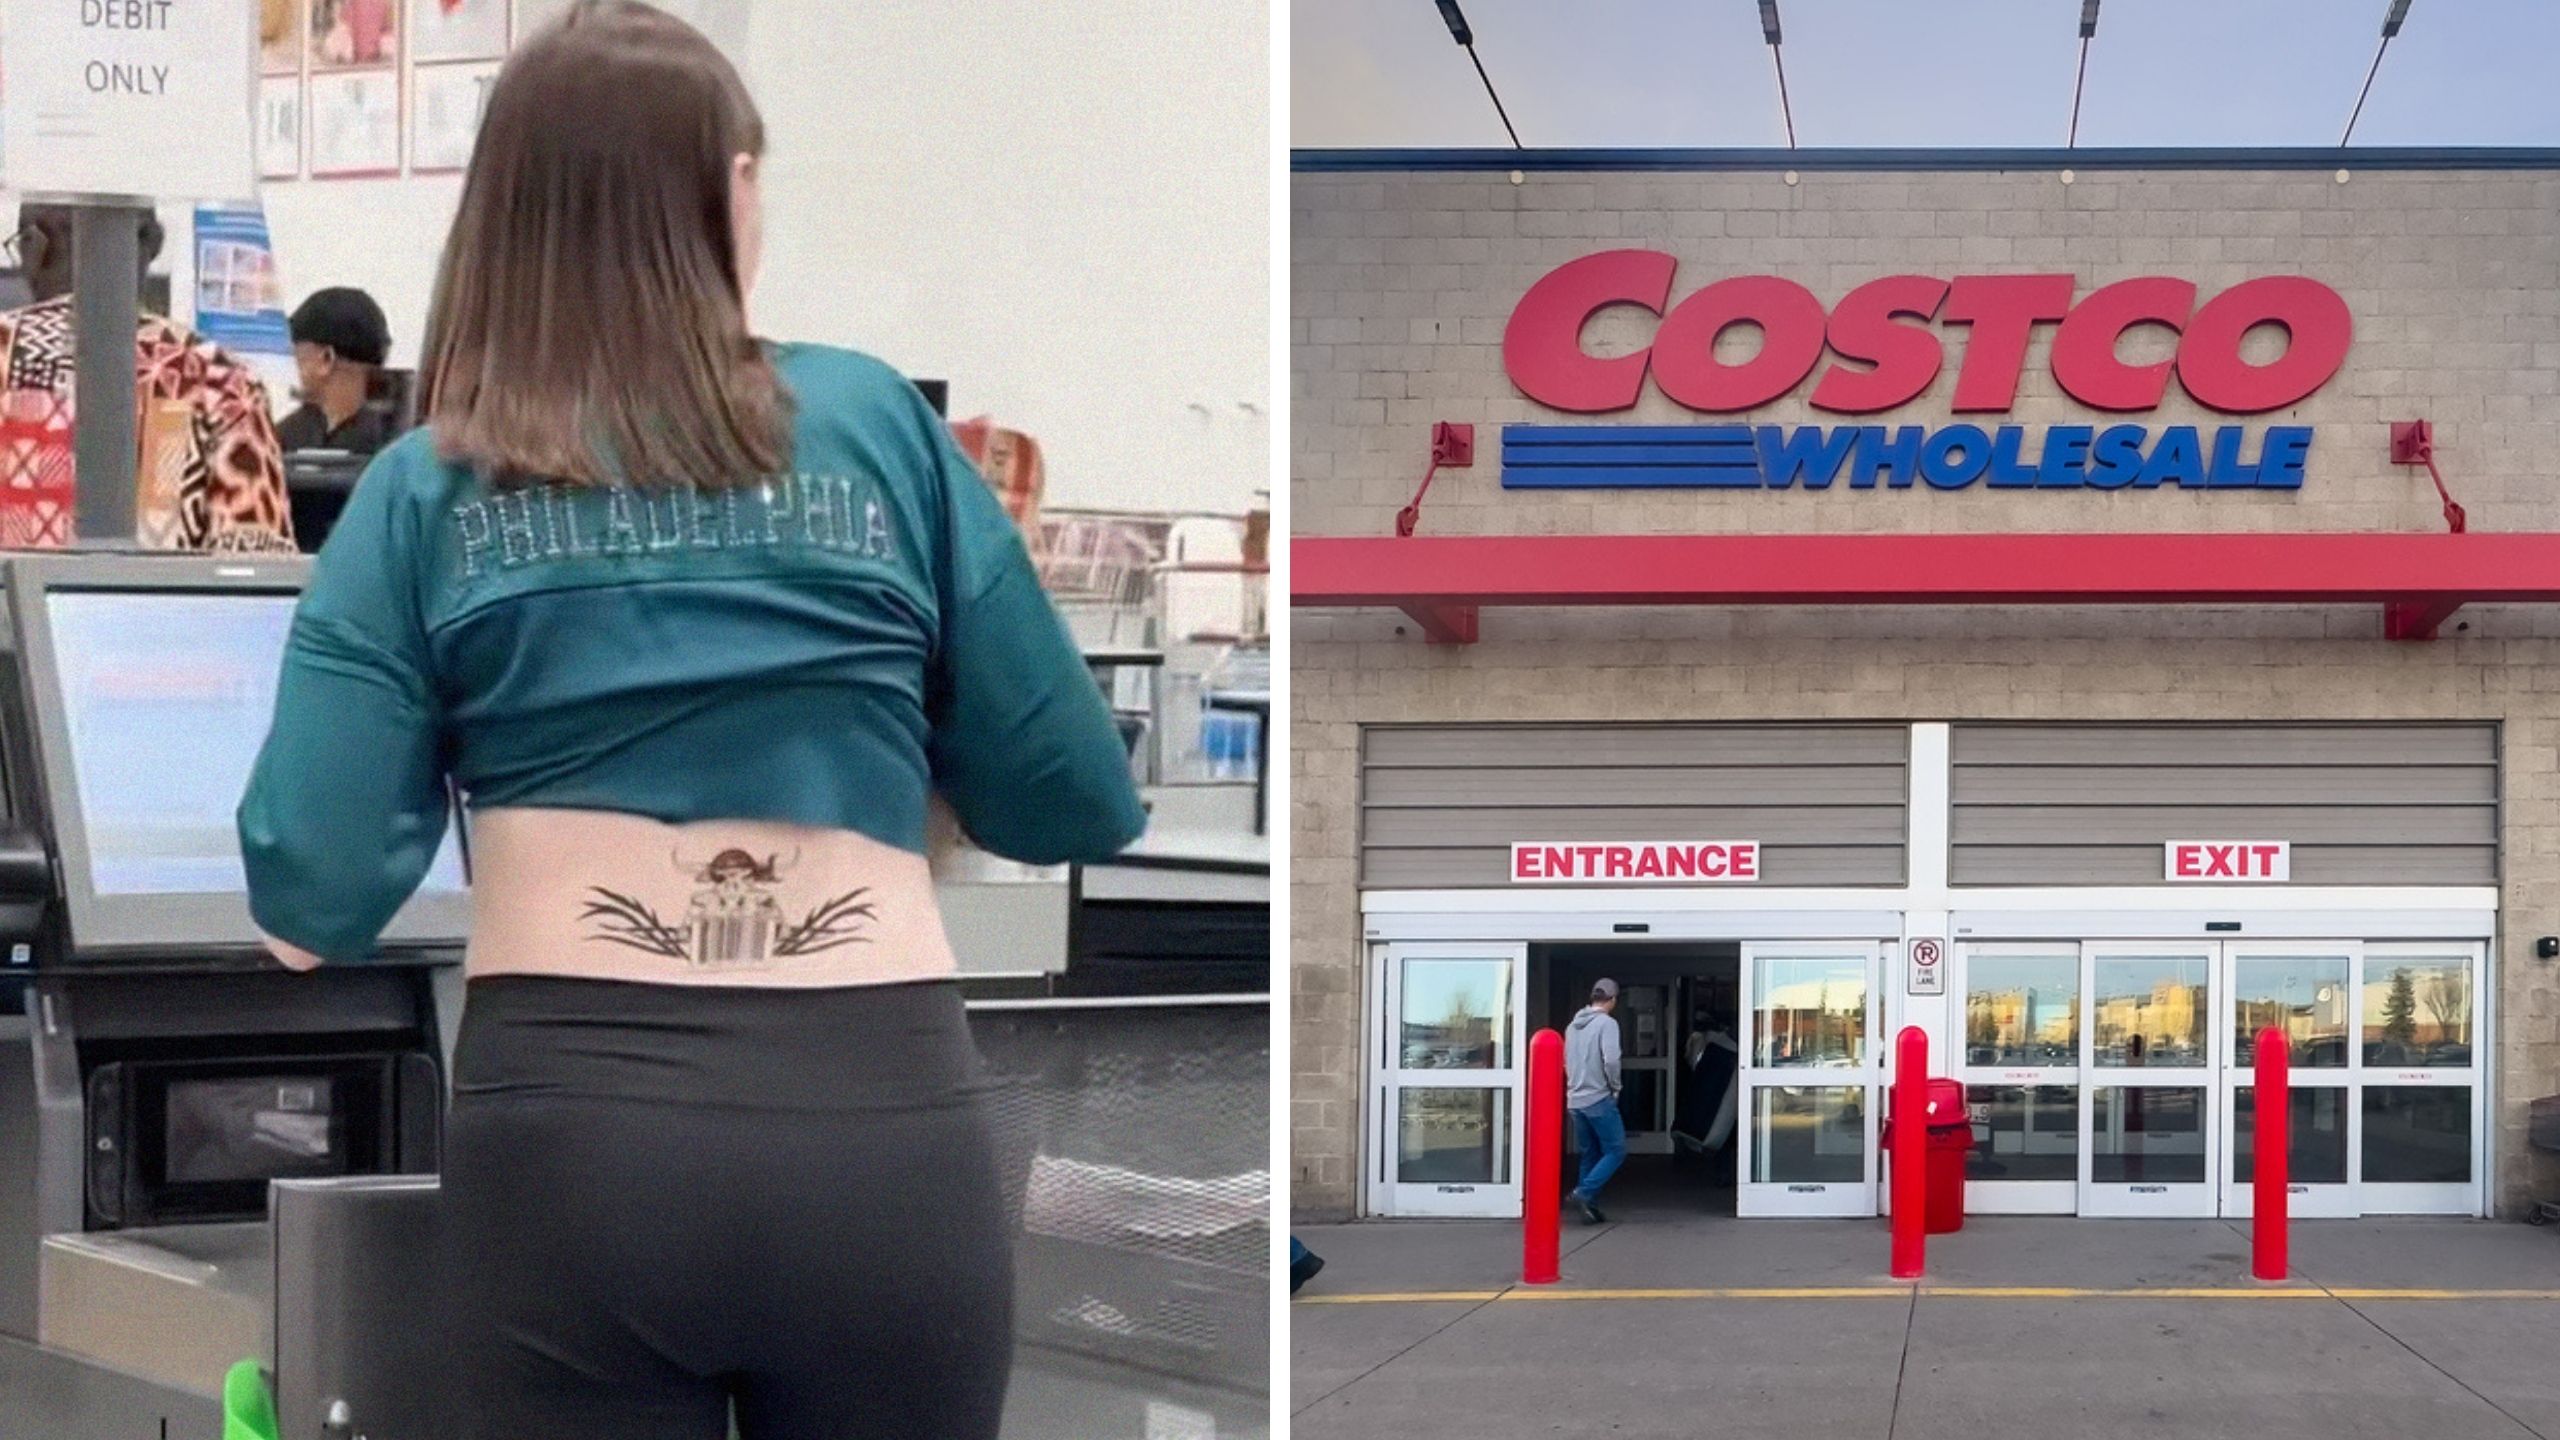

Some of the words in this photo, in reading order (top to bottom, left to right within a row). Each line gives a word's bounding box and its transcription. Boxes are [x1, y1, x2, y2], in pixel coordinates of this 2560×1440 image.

[81, 0, 172, 30] DEBIT
[85, 60, 169, 95] ONLY
[1503, 249, 2353, 412] COSTCO
[1756, 424, 2313, 490] WHOLESALE
[453, 474, 896, 577] PHILADELPHIA
[1516, 845, 1755, 878] ENTRANCE
[2176, 845, 2280, 877] EXIT
